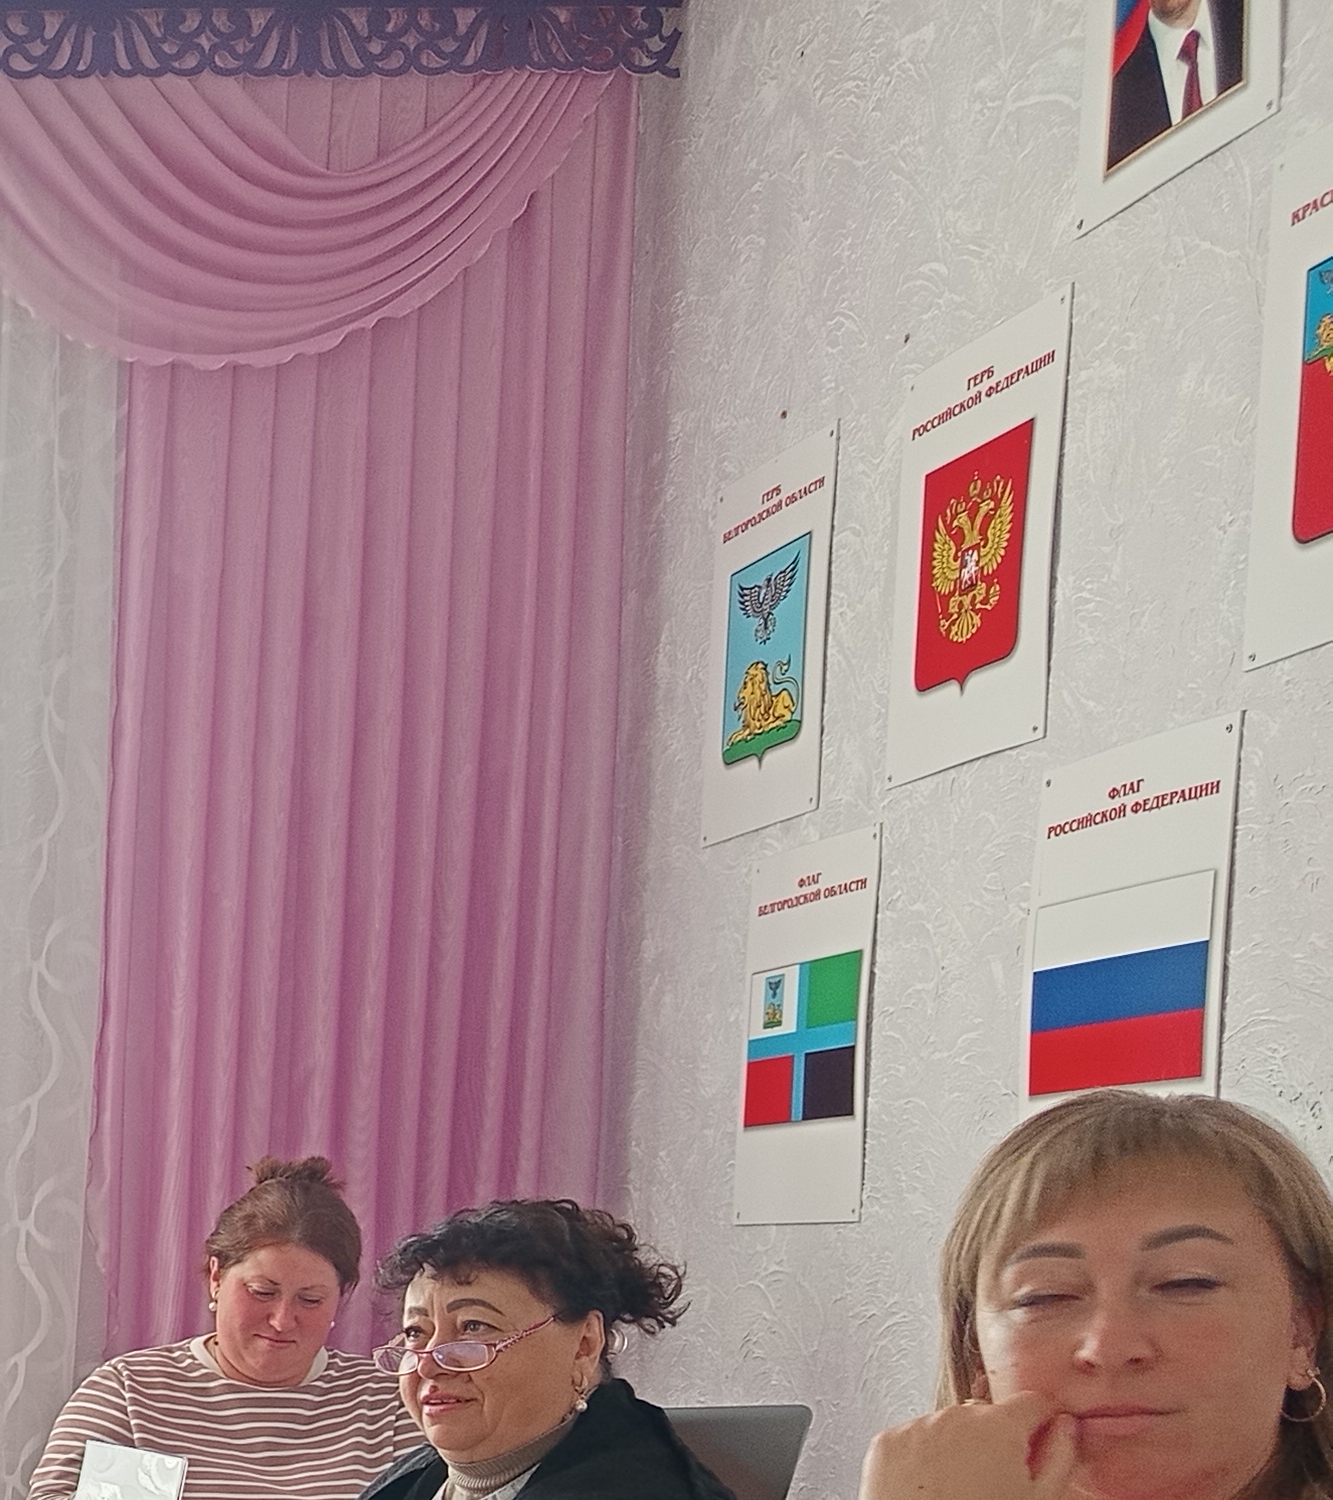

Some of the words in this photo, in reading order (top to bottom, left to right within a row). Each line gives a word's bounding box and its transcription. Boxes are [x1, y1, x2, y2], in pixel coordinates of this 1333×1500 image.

[1291, 189, 1333, 227] КРАС
[911, 389, 982, 441] РОССИЙСКОЙ
[985, 349, 1056, 398] ФЕДЕРАЦИИ
[966, 365, 995, 391] ГЕРБ
[722, 499, 783, 544] БЕЛГОРОДСКОЙ
[784, 475, 826, 507] ОБЛАСТИ
[761, 484, 782, 505] ГЕРБ
[1108, 778, 1144, 800] ФЛАГ
[1046, 803, 1127, 840] РОССИЙСКОЙ
[1130, 779, 1221, 815] ФЕДЕРАЦИИ
[757, 888, 822, 917] БЕЛГОРОДСКОЙ
[823, 877, 868, 899] ОБЛАСТИ
[797, 872, 822, 888] ФЛАГ
